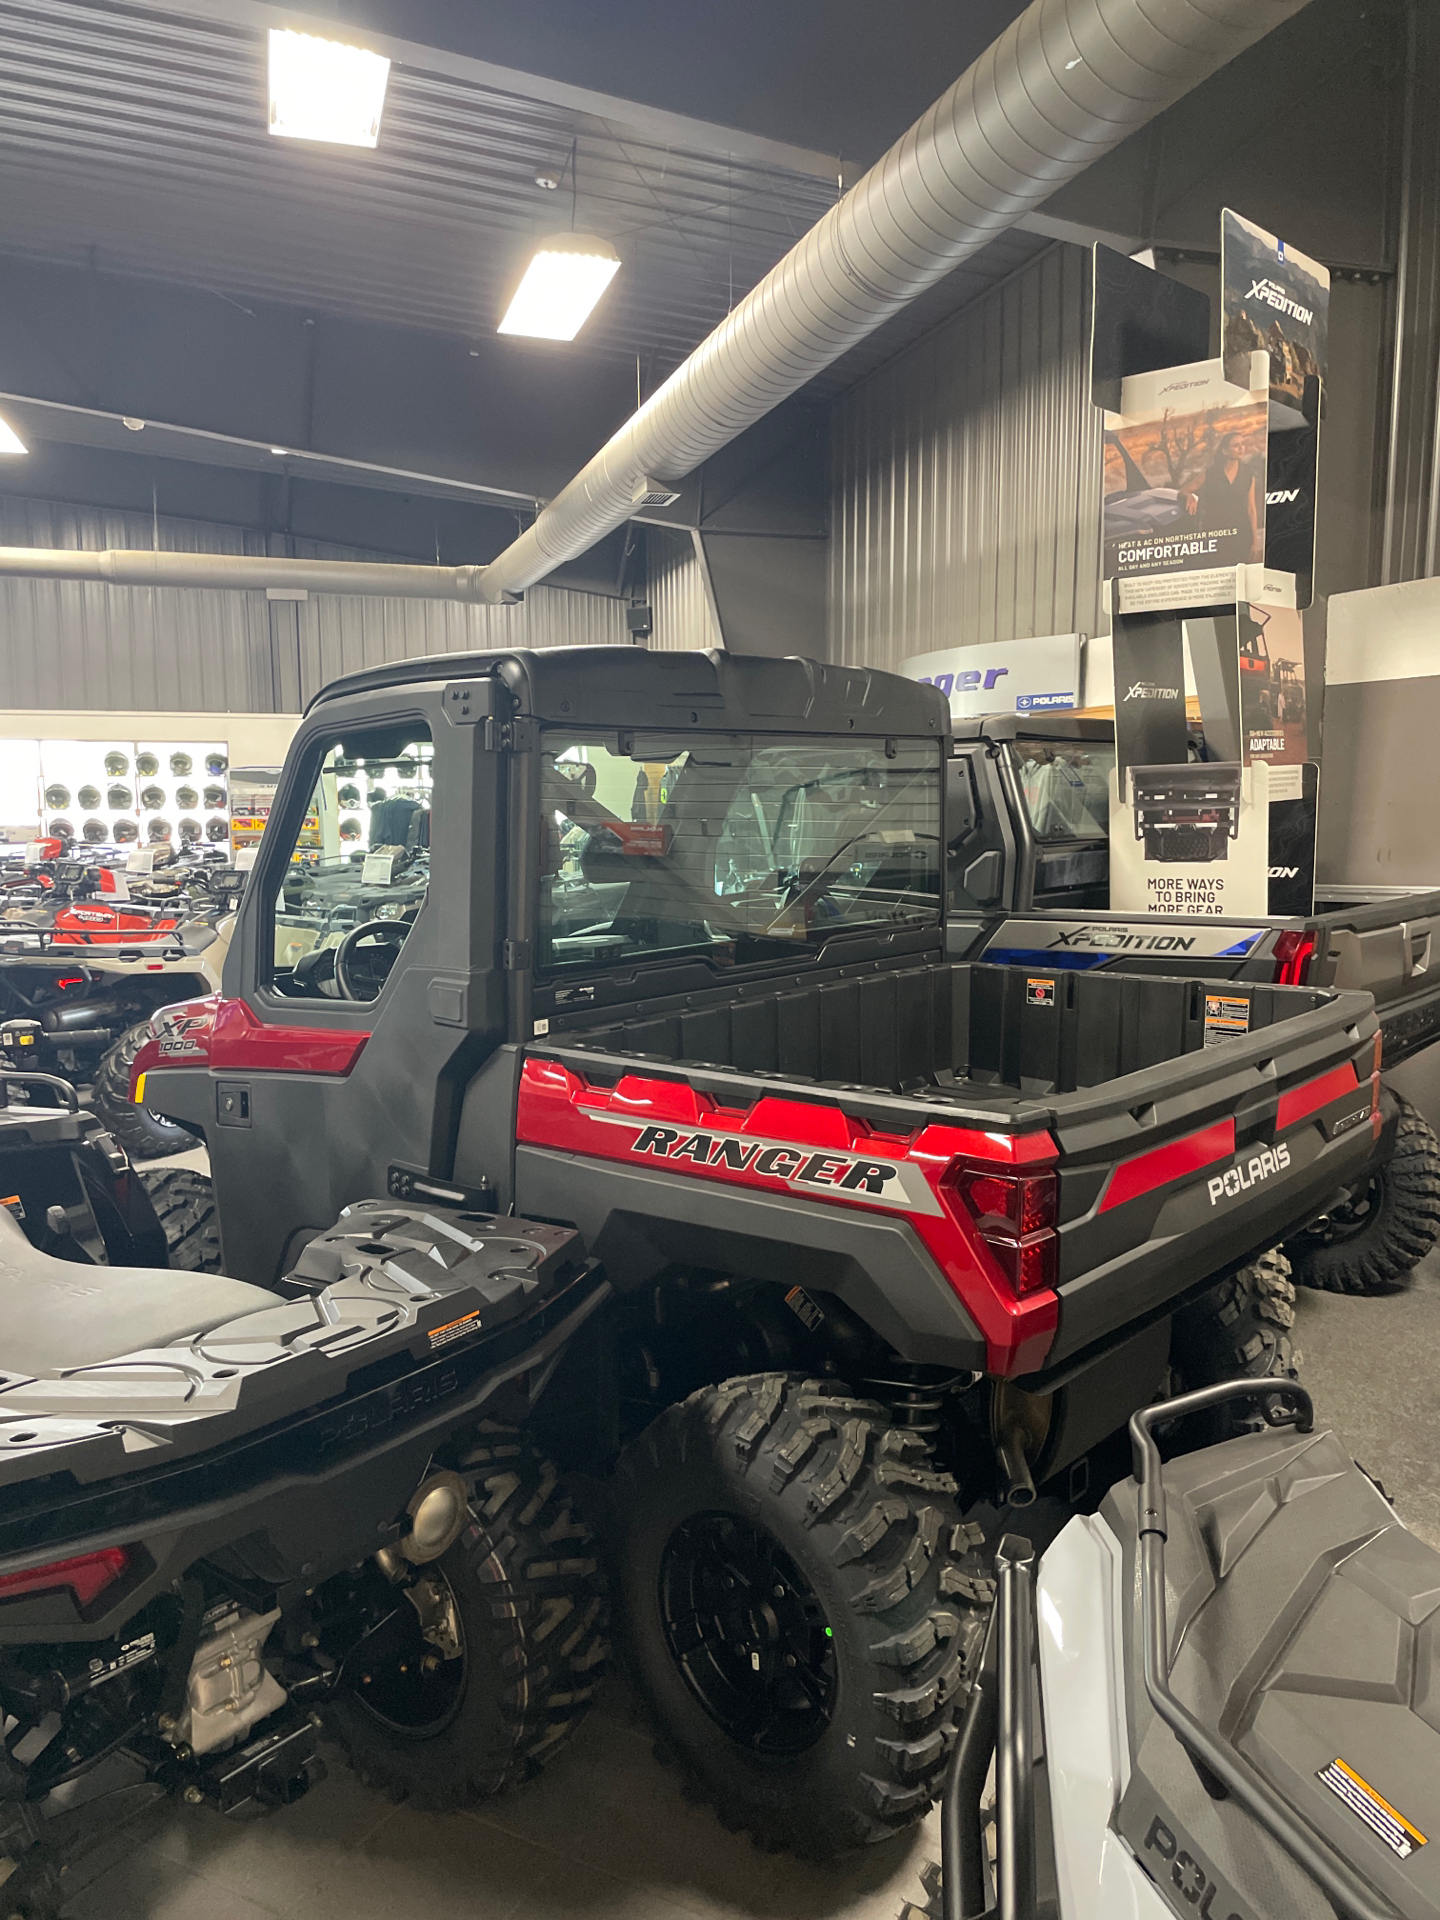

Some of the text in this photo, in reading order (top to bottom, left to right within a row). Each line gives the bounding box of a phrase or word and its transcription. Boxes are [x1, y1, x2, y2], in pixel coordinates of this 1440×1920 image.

[1244, 278, 1314, 326] XPEDITION
[1118, 540, 1136, 549] HEAT
[1154, 537, 1164, 545] ON
[1165, 532, 1207, 543] NORTHSTAR
[1208, 528, 1238, 538] MODELS
[1118, 539, 1218, 563] COMFORTABLE
[1032, 695, 1074, 706] POLARIS
[1123, 681, 1179, 702] XPEDITION
[1250, 738, 1286, 751] ADAPTABLE
[1148, 878, 1225, 890] MORE WAYS
[1155, 891, 1216, 903] TO BRING
[1148, 904, 1224, 915] MORE GEAR
[1045, 926, 1197, 951] XPEDITION
[155, 1018, 208, 1039] XP
[160, 1040, 196, 1052] 1000
[631, 1124, 899, 1195] RANGER
[1207, 1142, 1291, 1206] POLARIS
[1143, 1814, 1244, 1920] POL
